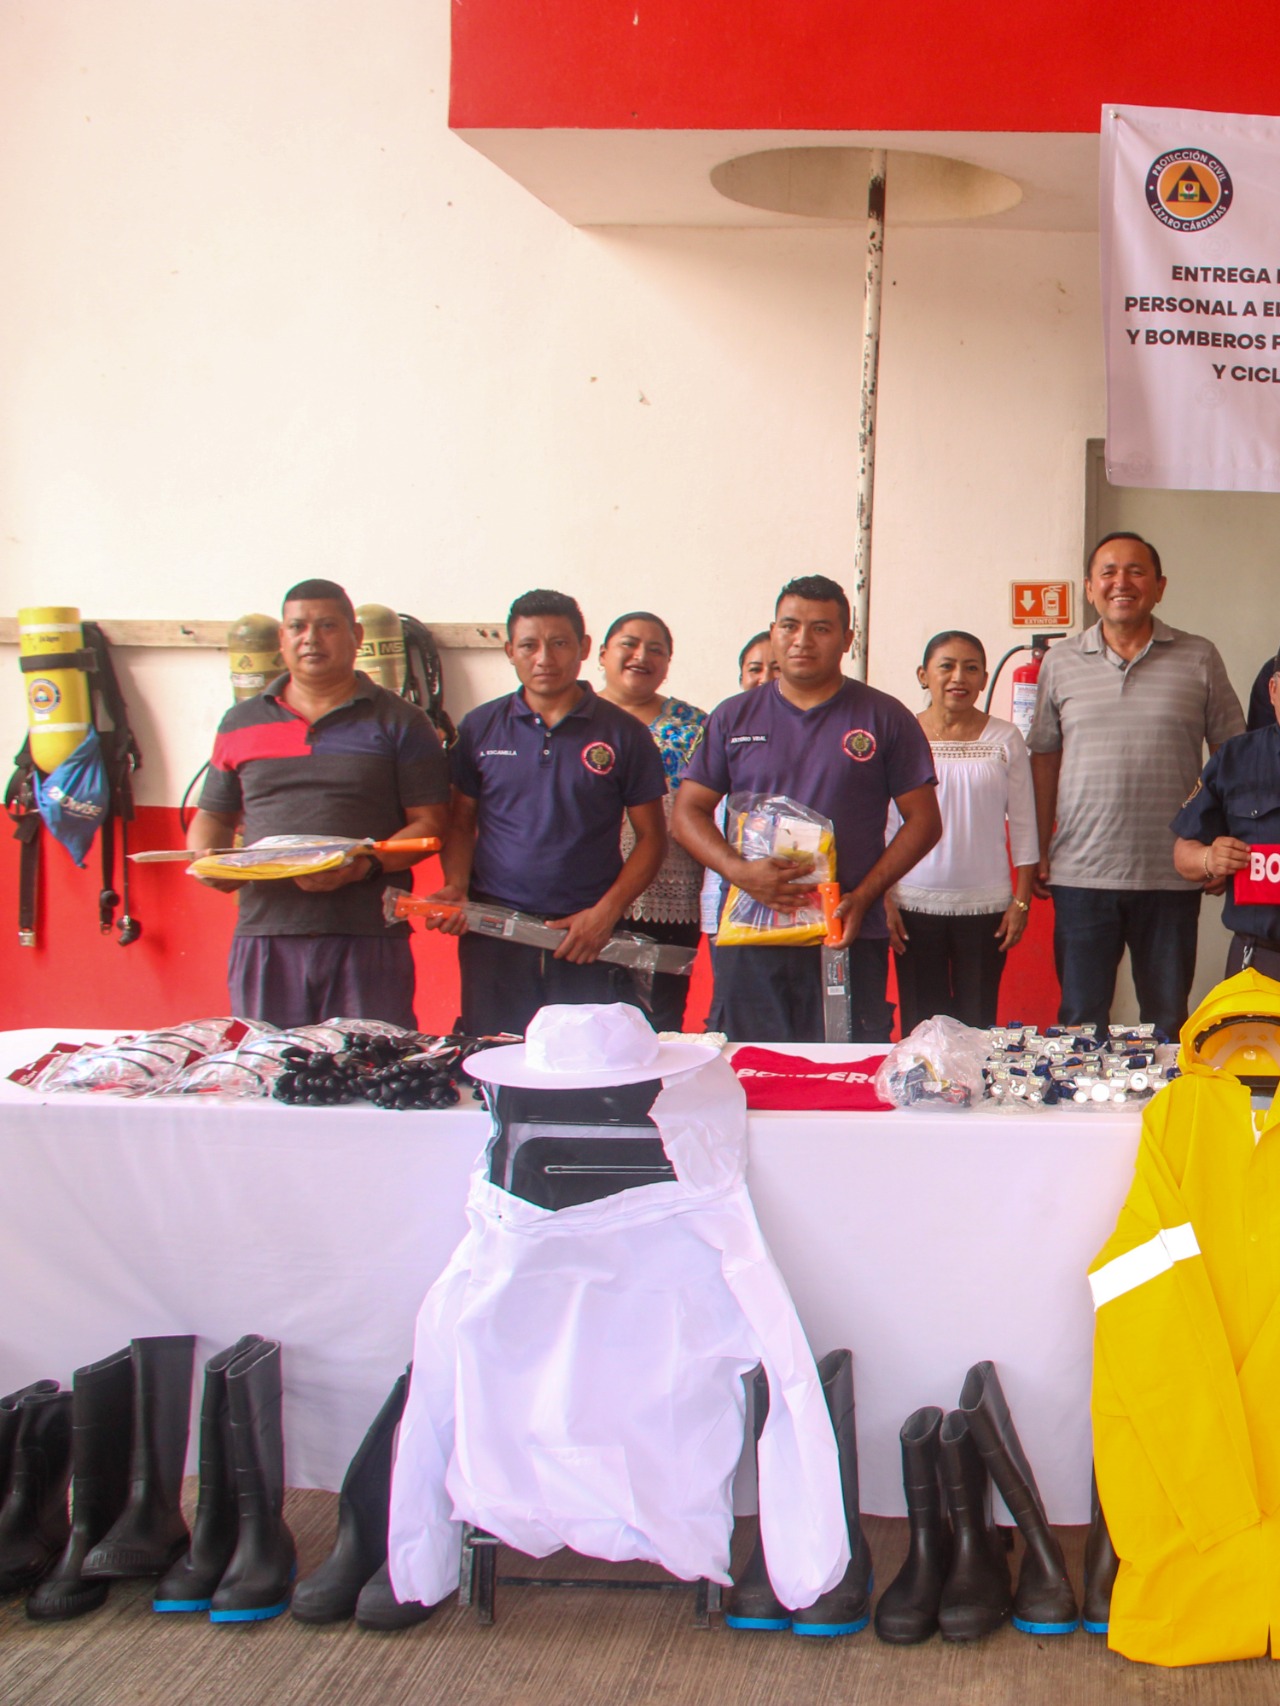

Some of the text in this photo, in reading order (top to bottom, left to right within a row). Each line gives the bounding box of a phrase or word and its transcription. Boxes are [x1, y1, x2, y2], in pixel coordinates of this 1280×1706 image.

[1152, 151, 1227, 182] PROTECCIÓN CIVIL
[1151, 203, 1227, 231] LÁZARO CÁRDENAS
[1171, 265, 1271, 284] ENTREGA
[1124, 296, 1237, 316] PERSONAL
[1242, 301, 1257, 317] A
[1126, 329, 1140, 345] Y
[1145, 329, 1266, 350] BOMBEROS
[1212, 363, 1226, 379] Y
